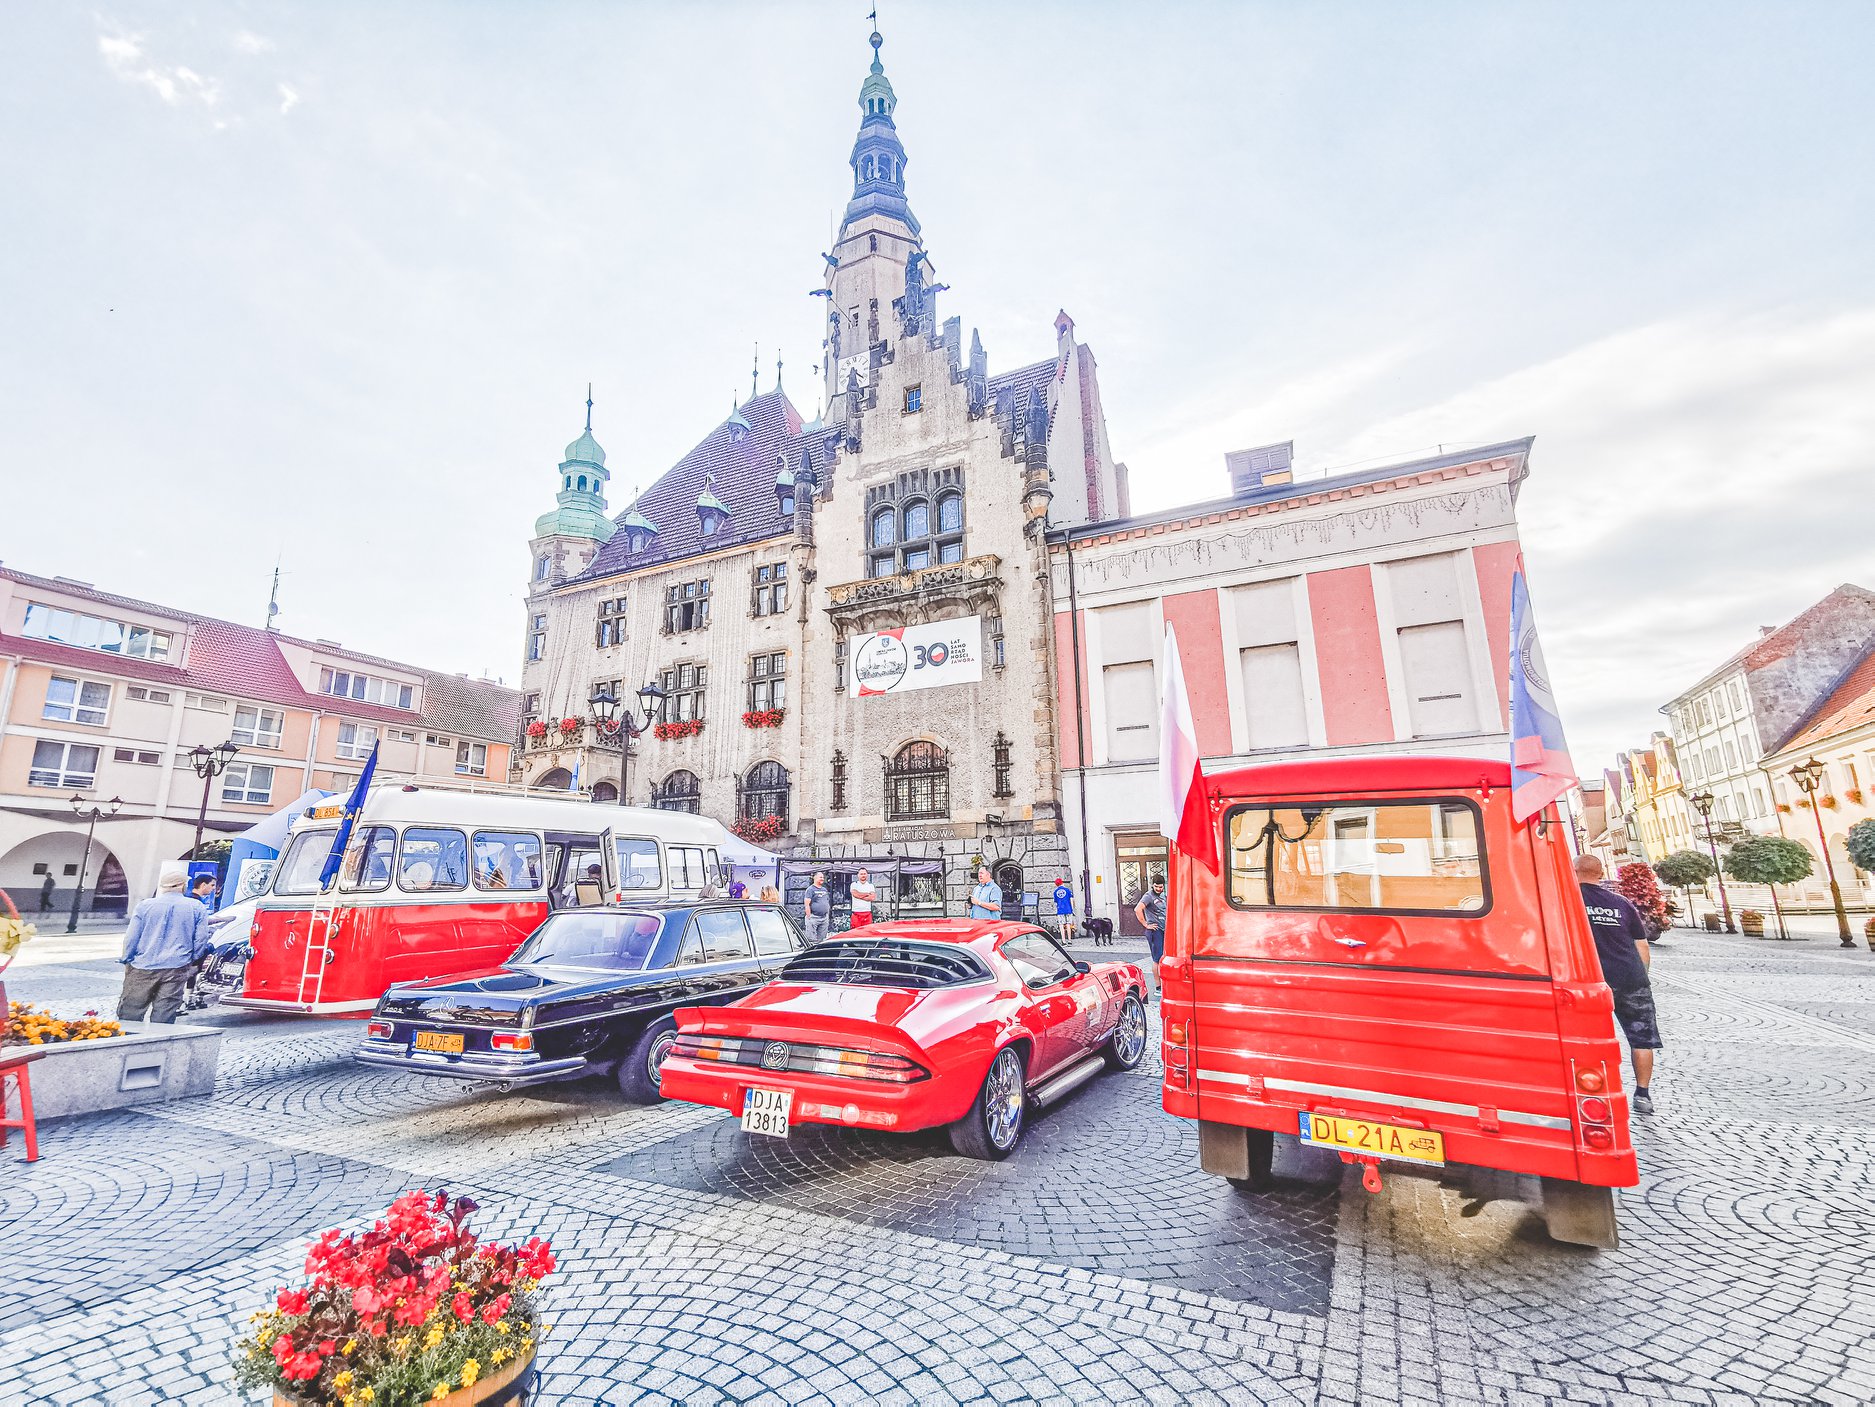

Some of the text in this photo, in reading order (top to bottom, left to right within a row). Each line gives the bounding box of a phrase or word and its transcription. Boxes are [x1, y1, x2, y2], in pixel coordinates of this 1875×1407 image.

[914, 642, 949, 670] 30
[893, 829, 956, 840] RATUSZOWA
[417, 1033, 434, 1048] DJA
[754, 1091, 782, 1112] DJA
[746, 1111, 786, 1134] 13813
[1314, 1118, 1403, 1153] DL 21A
